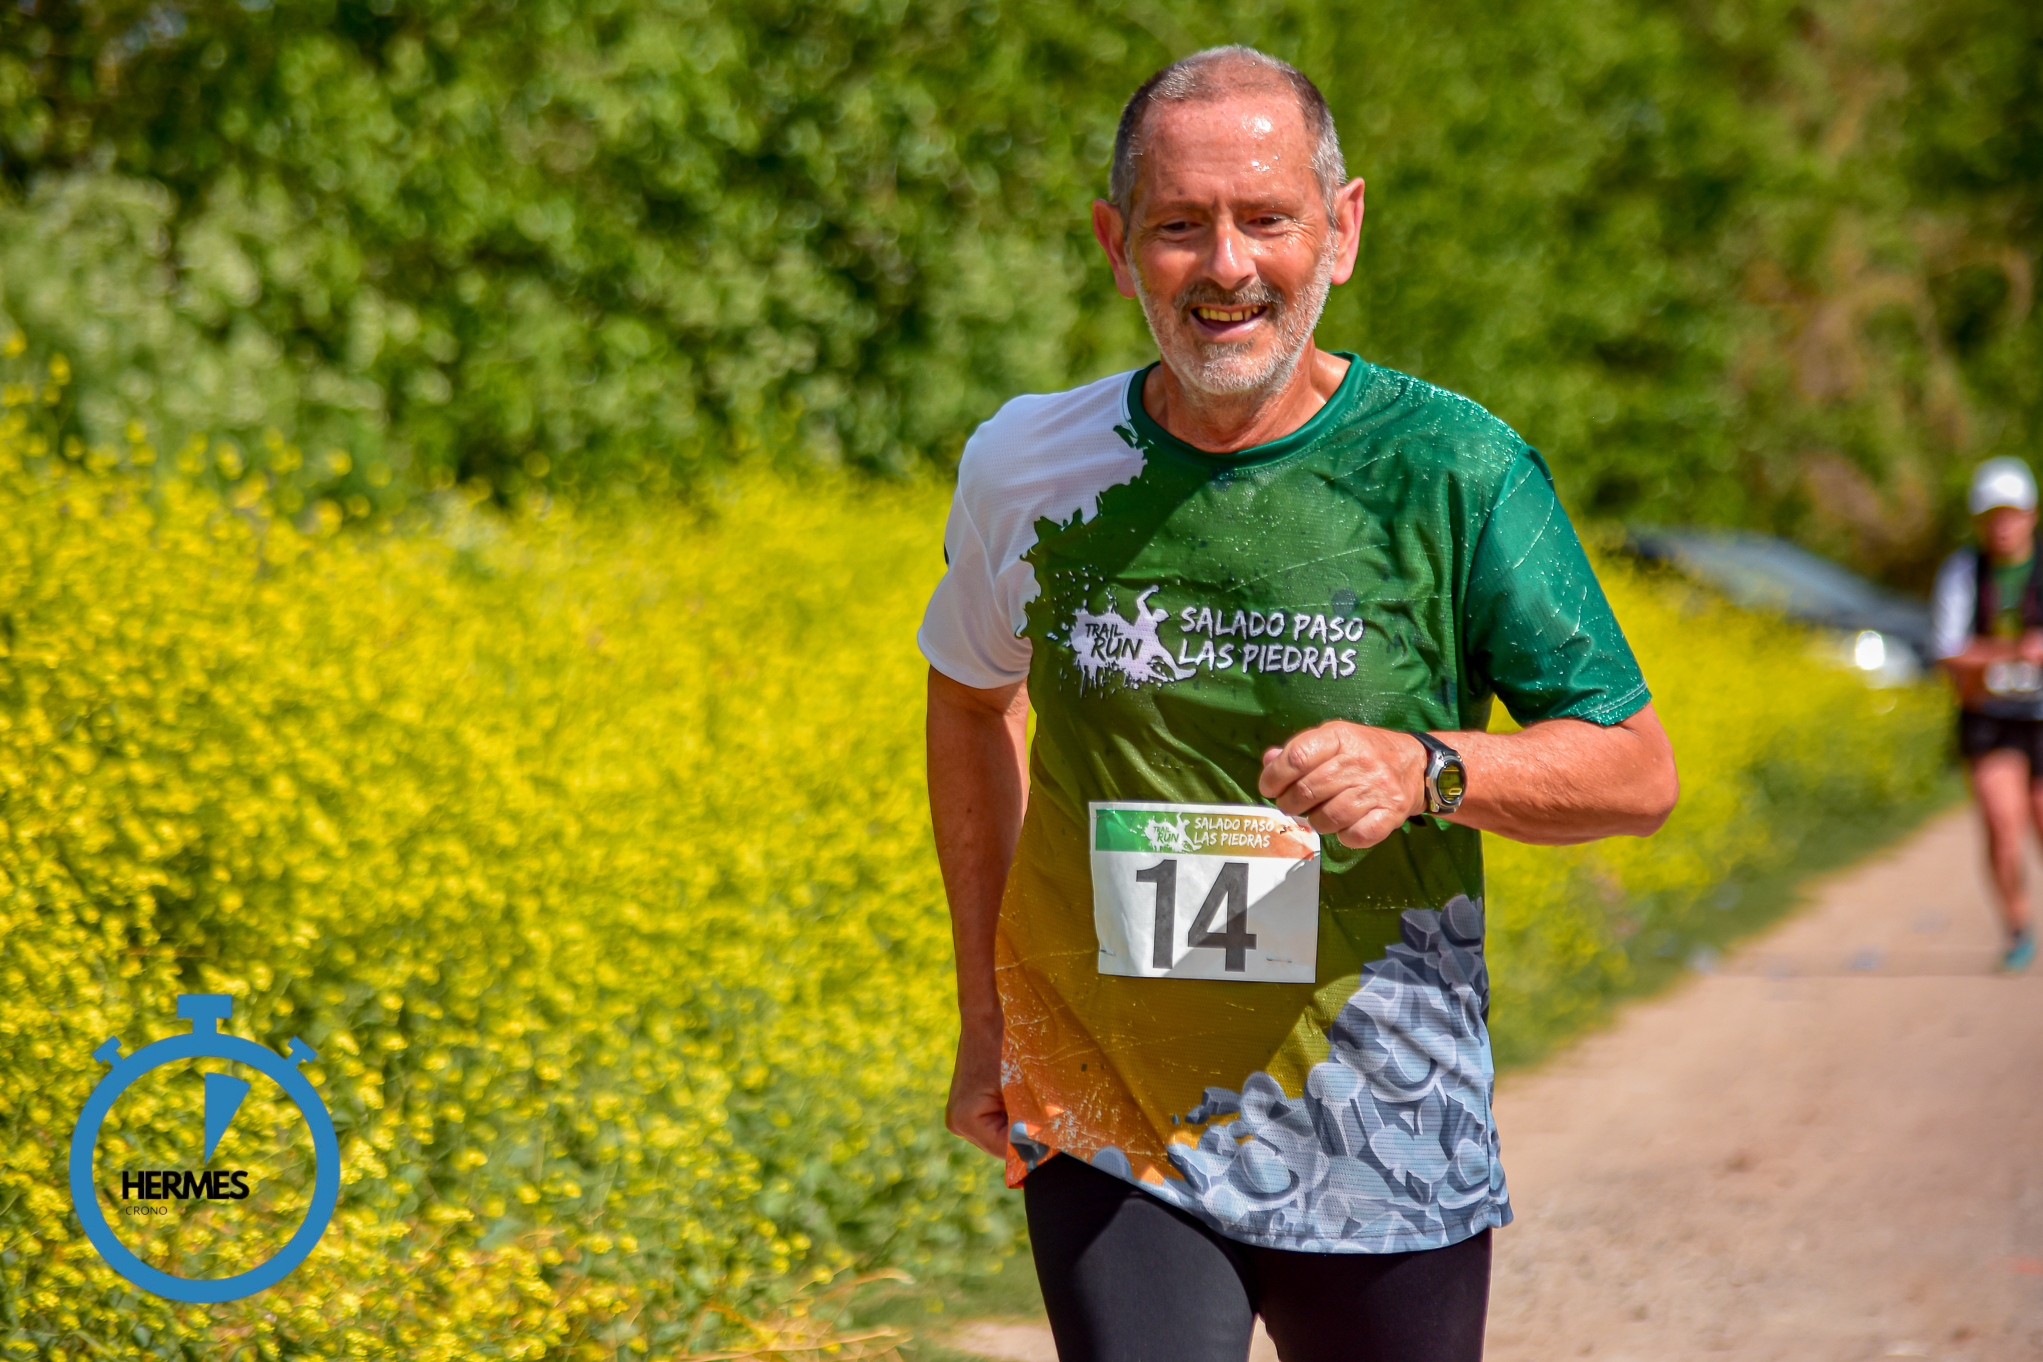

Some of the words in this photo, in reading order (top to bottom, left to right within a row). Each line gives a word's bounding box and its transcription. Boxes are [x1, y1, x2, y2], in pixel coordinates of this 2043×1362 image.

[1085, 623, 1124, 638] TRAIL
[1180, 606, 1284, 638] SALADO
[1294, 613, 1365, 645] PASO
[1091, 637, 1143, 661] RUN
[1178, 639, 1235, 671] LAS
[1241, 644, 1358, 680] PIEDRAS
[1194, 817, 1241, 831] SALADO
[1244, 819, 1275, 832] PASO
[1157, 833, 1180, 843] RUN
[1194, 832, 1218, 846] LAS
[1221, 833, 1271, 848] PIEDRAS
[1136, 859, 1257, 973] 14
